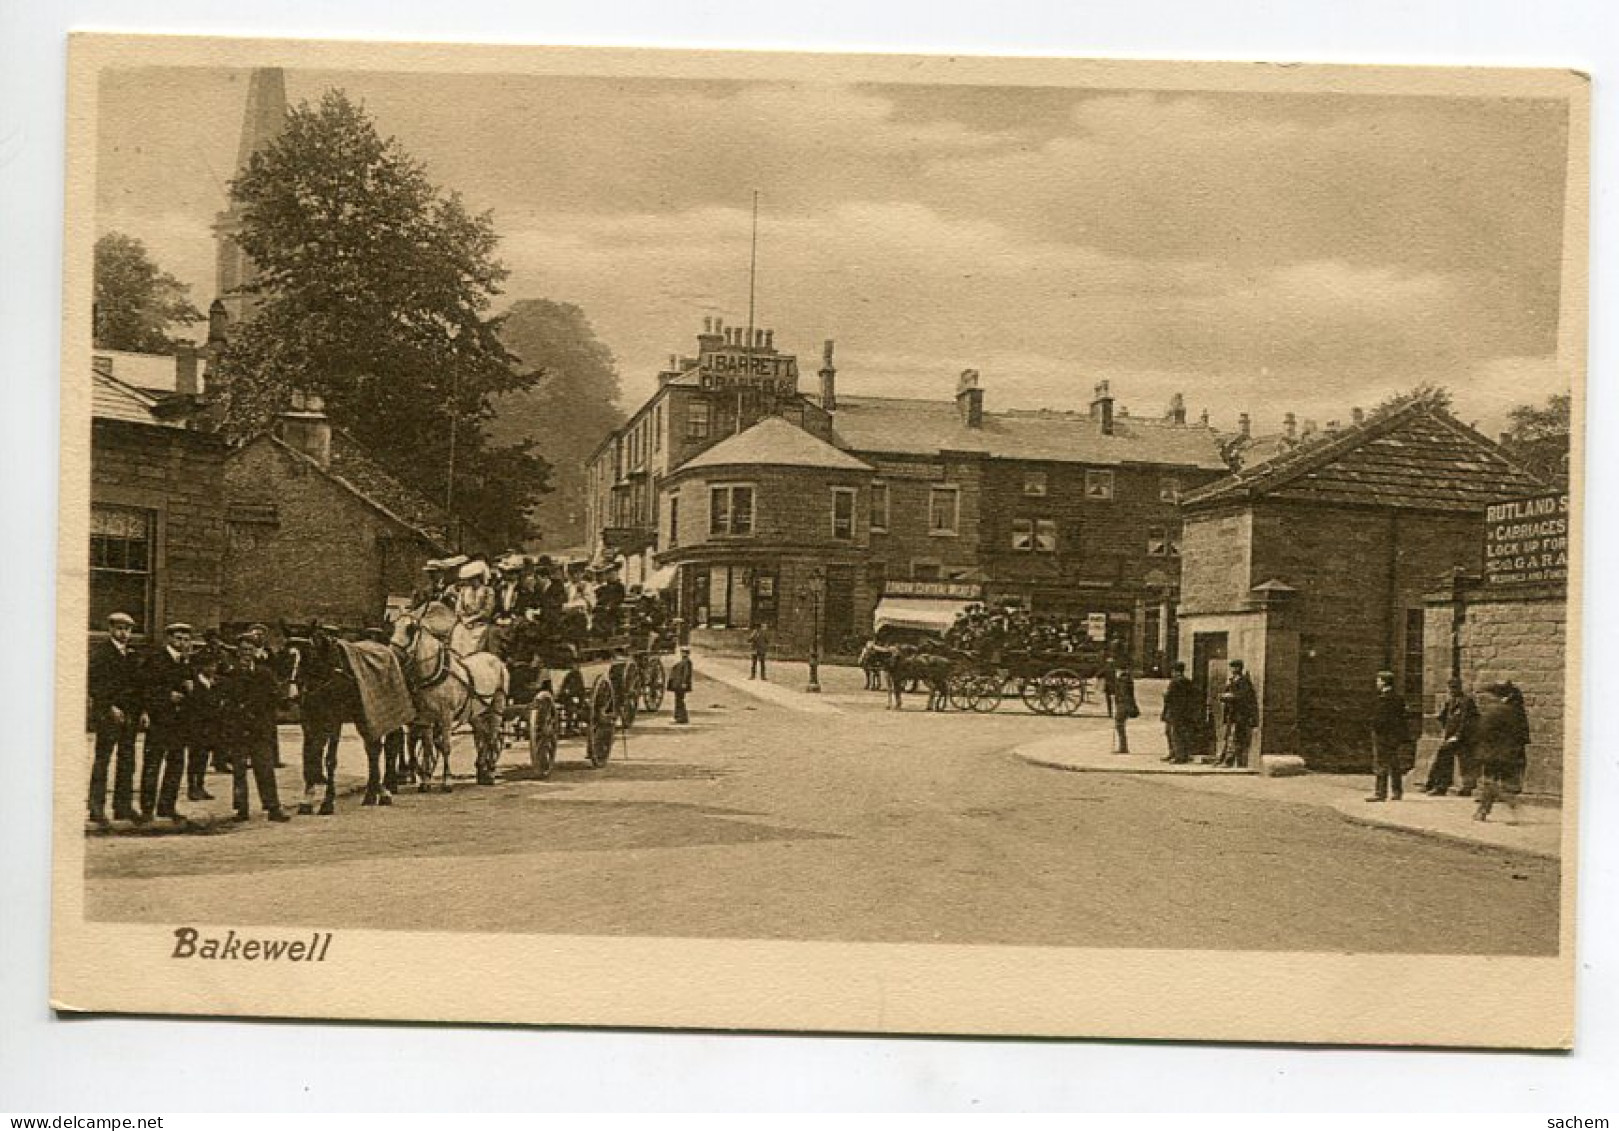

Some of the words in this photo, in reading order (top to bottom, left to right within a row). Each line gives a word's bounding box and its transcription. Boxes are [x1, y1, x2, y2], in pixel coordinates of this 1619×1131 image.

[1487, 498, 1556, 522] RUTLAND
[1496, 519, 1566, 541] CARRIAGES
[1487, 543, 1519, 557] LOCK
